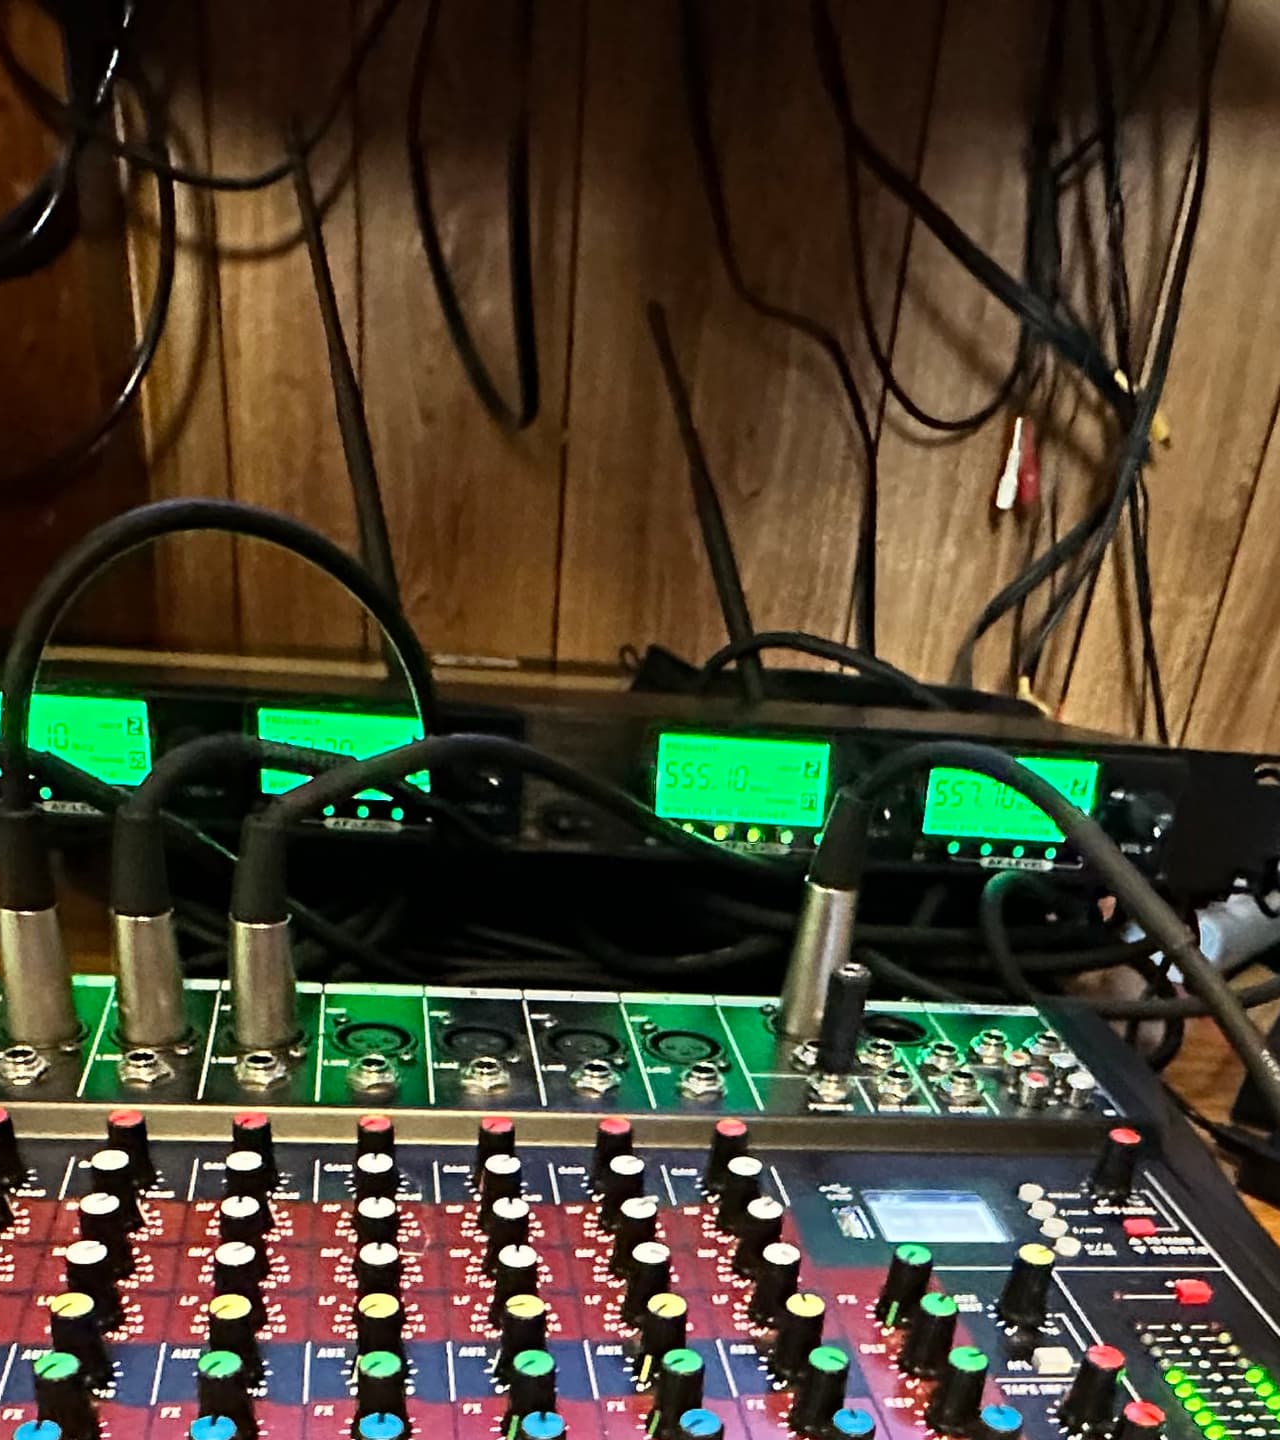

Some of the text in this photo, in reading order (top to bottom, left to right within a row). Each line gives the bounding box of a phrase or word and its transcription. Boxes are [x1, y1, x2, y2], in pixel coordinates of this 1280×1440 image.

[170, 1348, 202, 1360] AUX
[316, 1347, 346, 1359] AUX
[458, 1346, 487, 1357] AUX
[2, 1408, 25, 1420] FX
[160, 1407, 182, 1419] FX
[313, 1405, 334, 1417] FX
[462, 1403, 482, 1414] FX
